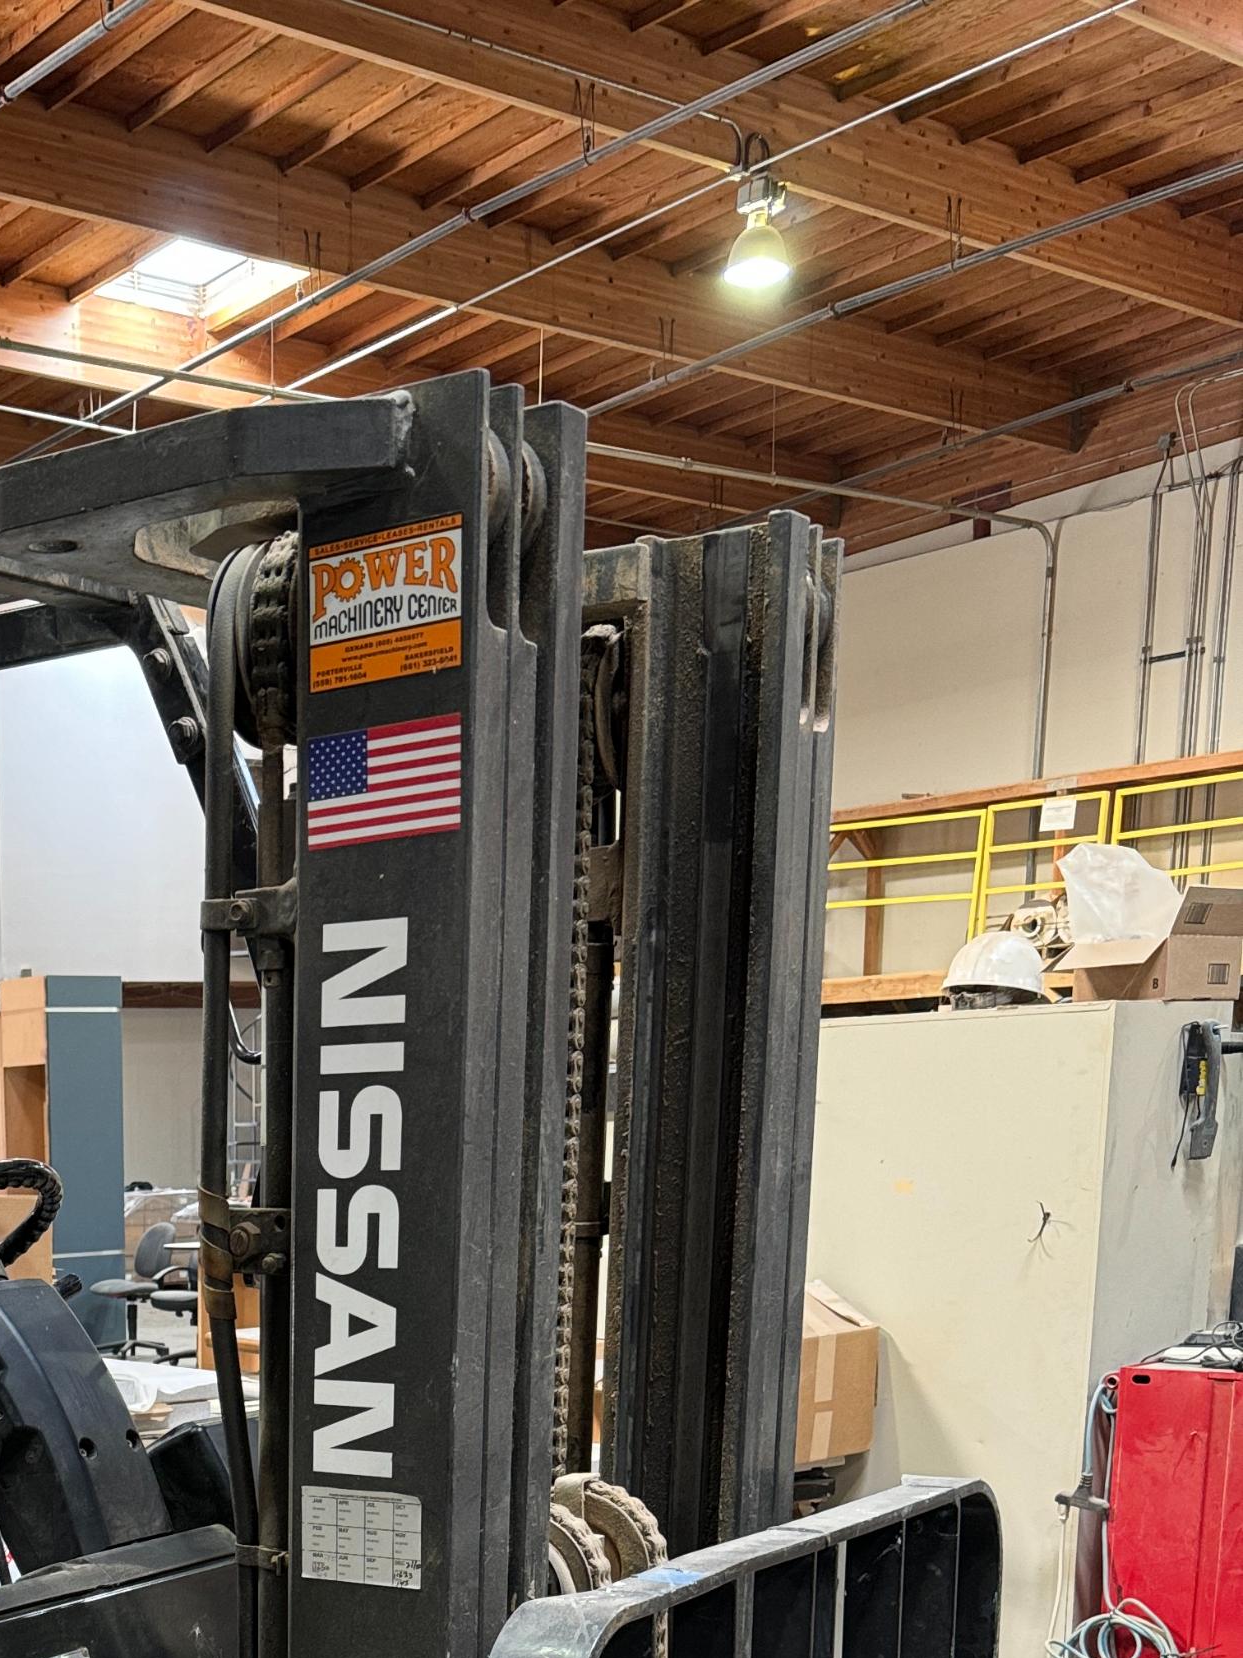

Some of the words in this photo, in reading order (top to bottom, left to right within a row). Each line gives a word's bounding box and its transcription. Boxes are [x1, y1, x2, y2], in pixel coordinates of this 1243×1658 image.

[311, 536, 458, 623] POWER
[313, 595, 404, 641] MACHINERY
[408, 593, 457, 621] CENTER
[313, 916, 409, 1479] NISSAN
